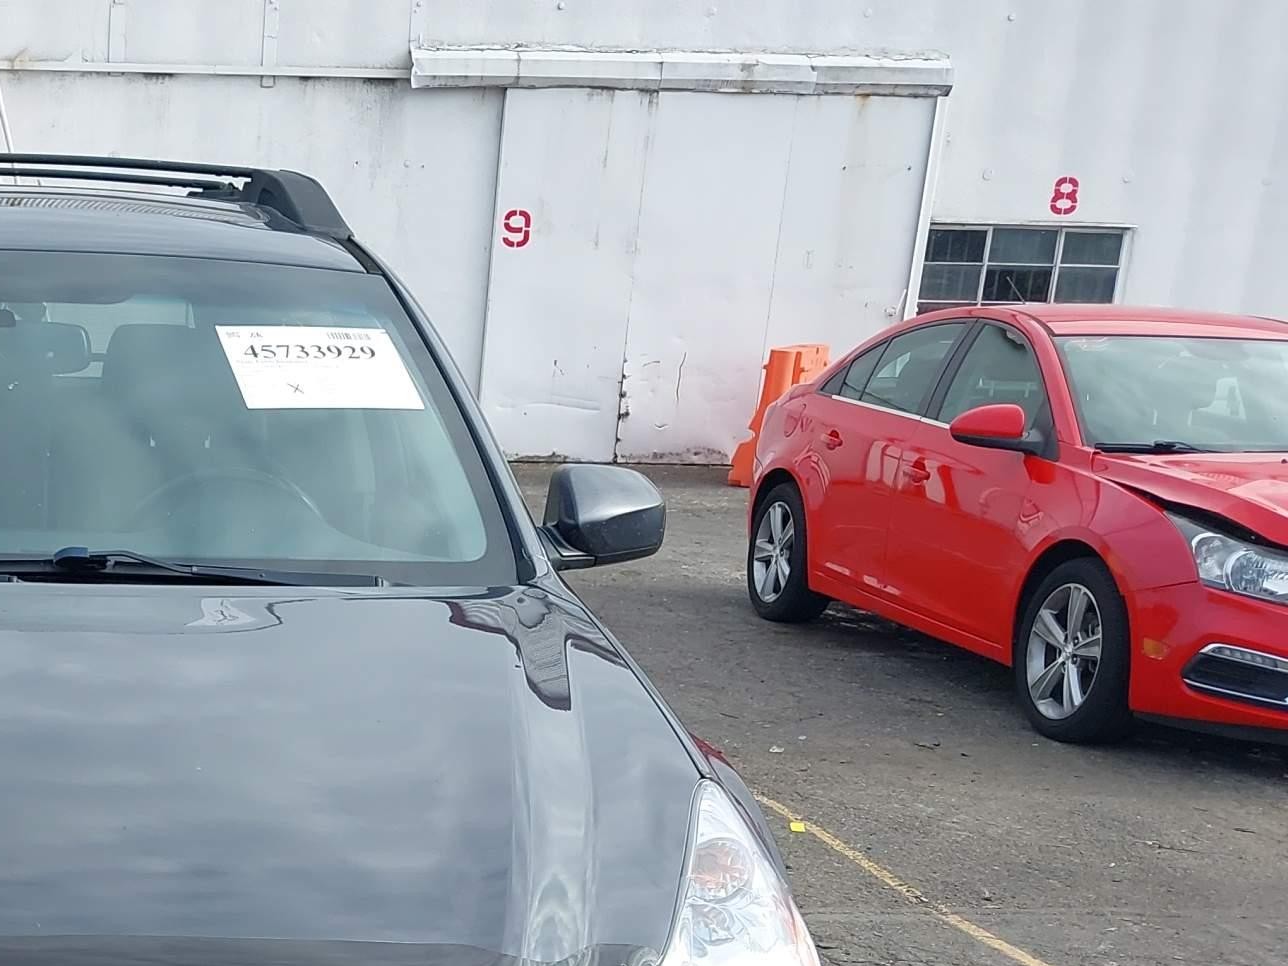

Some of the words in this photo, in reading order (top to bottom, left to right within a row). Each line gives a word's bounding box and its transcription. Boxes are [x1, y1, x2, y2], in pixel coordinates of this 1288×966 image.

[1049, 176, 1080, 216] 8
[503, 209, 532, 249] 9
[244, 344, 376, 360] 45733929
